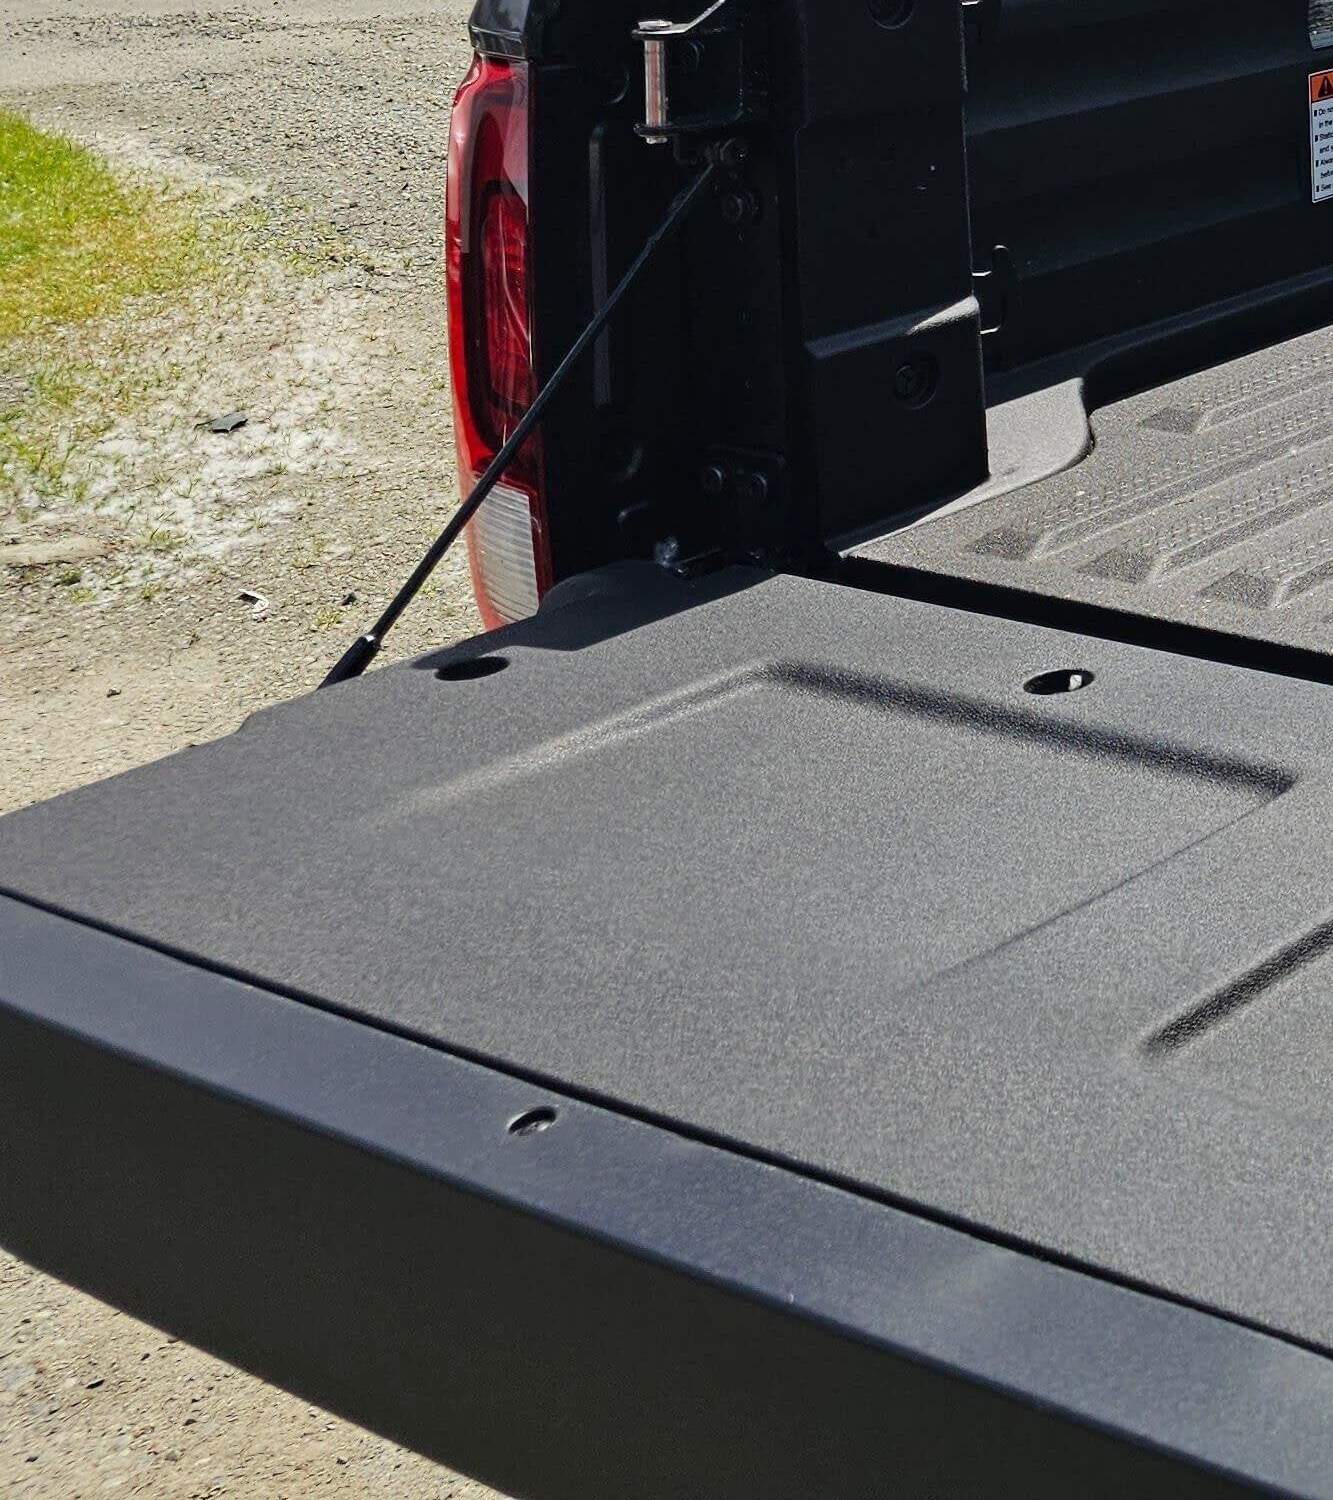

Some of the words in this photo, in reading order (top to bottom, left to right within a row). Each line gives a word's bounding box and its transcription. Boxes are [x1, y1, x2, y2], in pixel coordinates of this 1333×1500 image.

[1318, 108, 1326, 117] Do
[1324, 118, 1333, 127] the
[1319, 130, 1333, 142] Static
[1319, 145, 1330, 154] and
[1320, 183, 1332, 192] See
